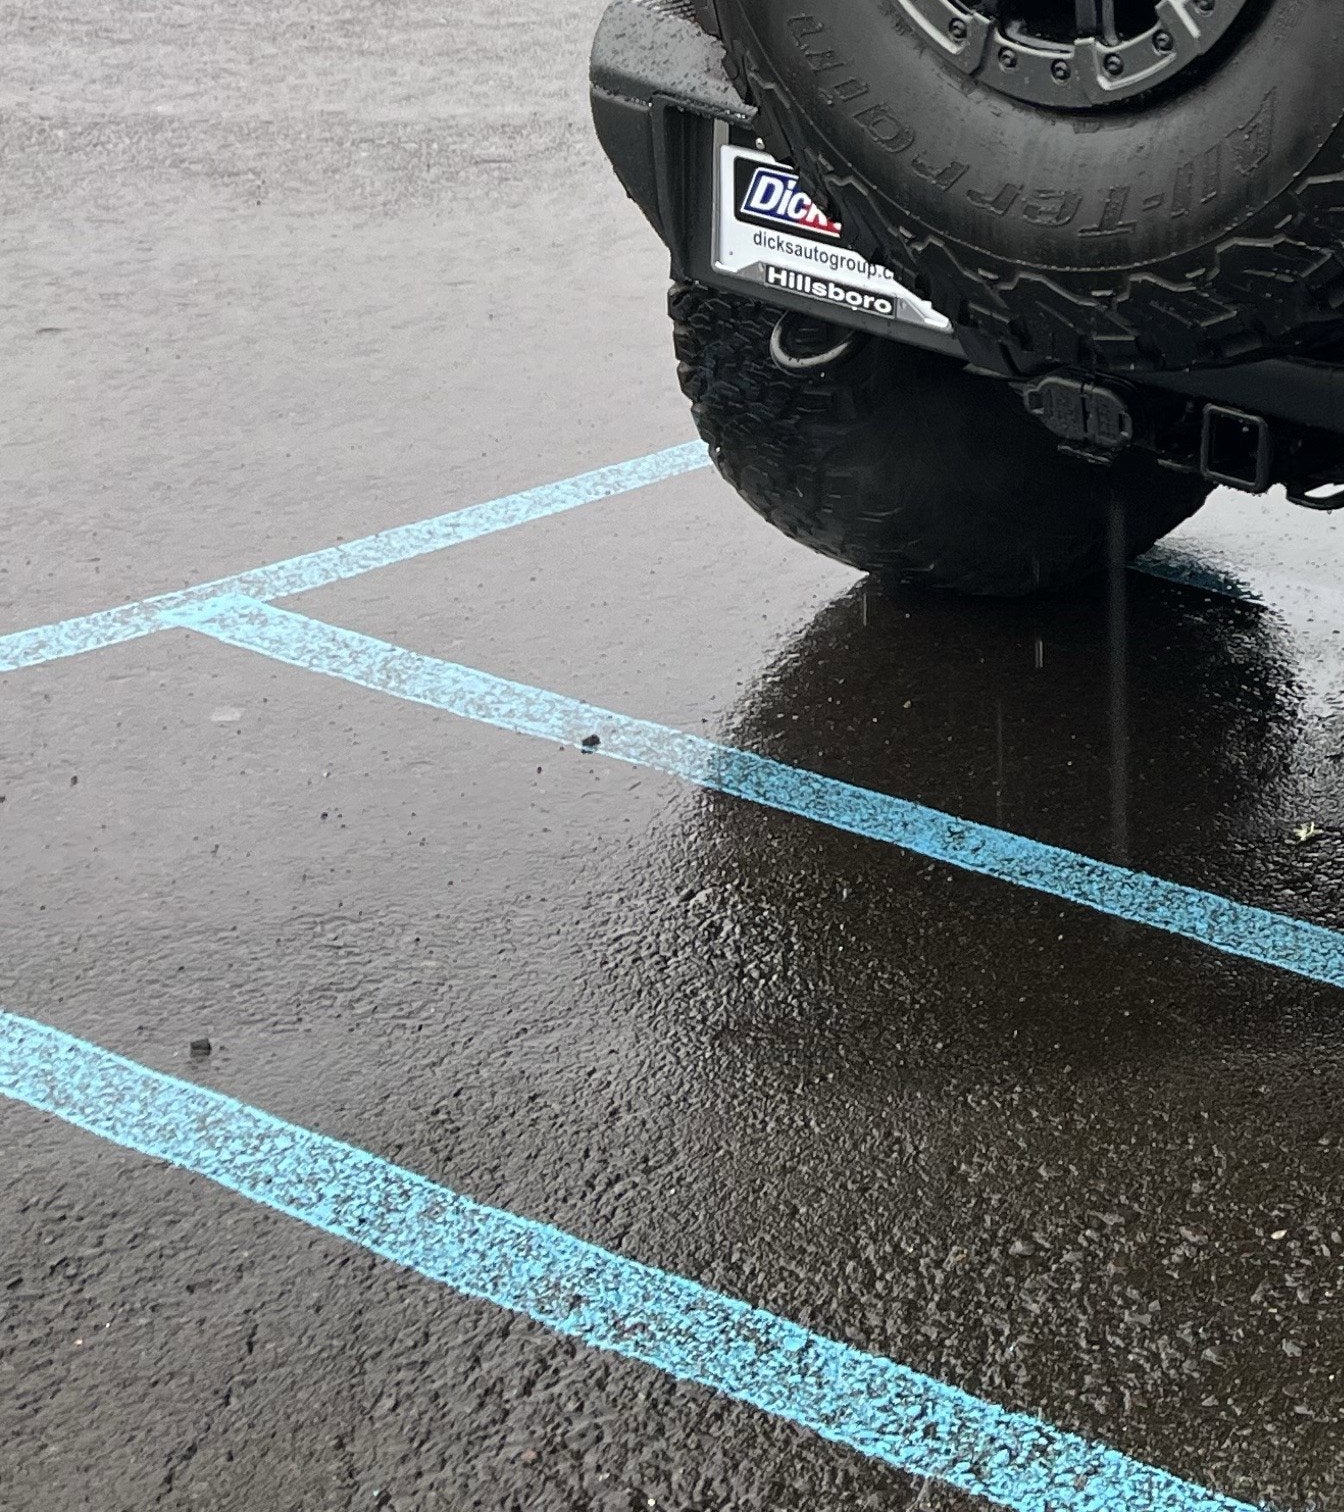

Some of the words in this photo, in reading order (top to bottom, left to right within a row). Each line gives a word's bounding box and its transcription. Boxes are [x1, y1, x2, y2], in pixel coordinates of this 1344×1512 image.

[749, 175, 842, 229] Dick
[753, 230, 894, 280] dicksautogroup.c
[766, 265, 893, 315] Hillsboro
